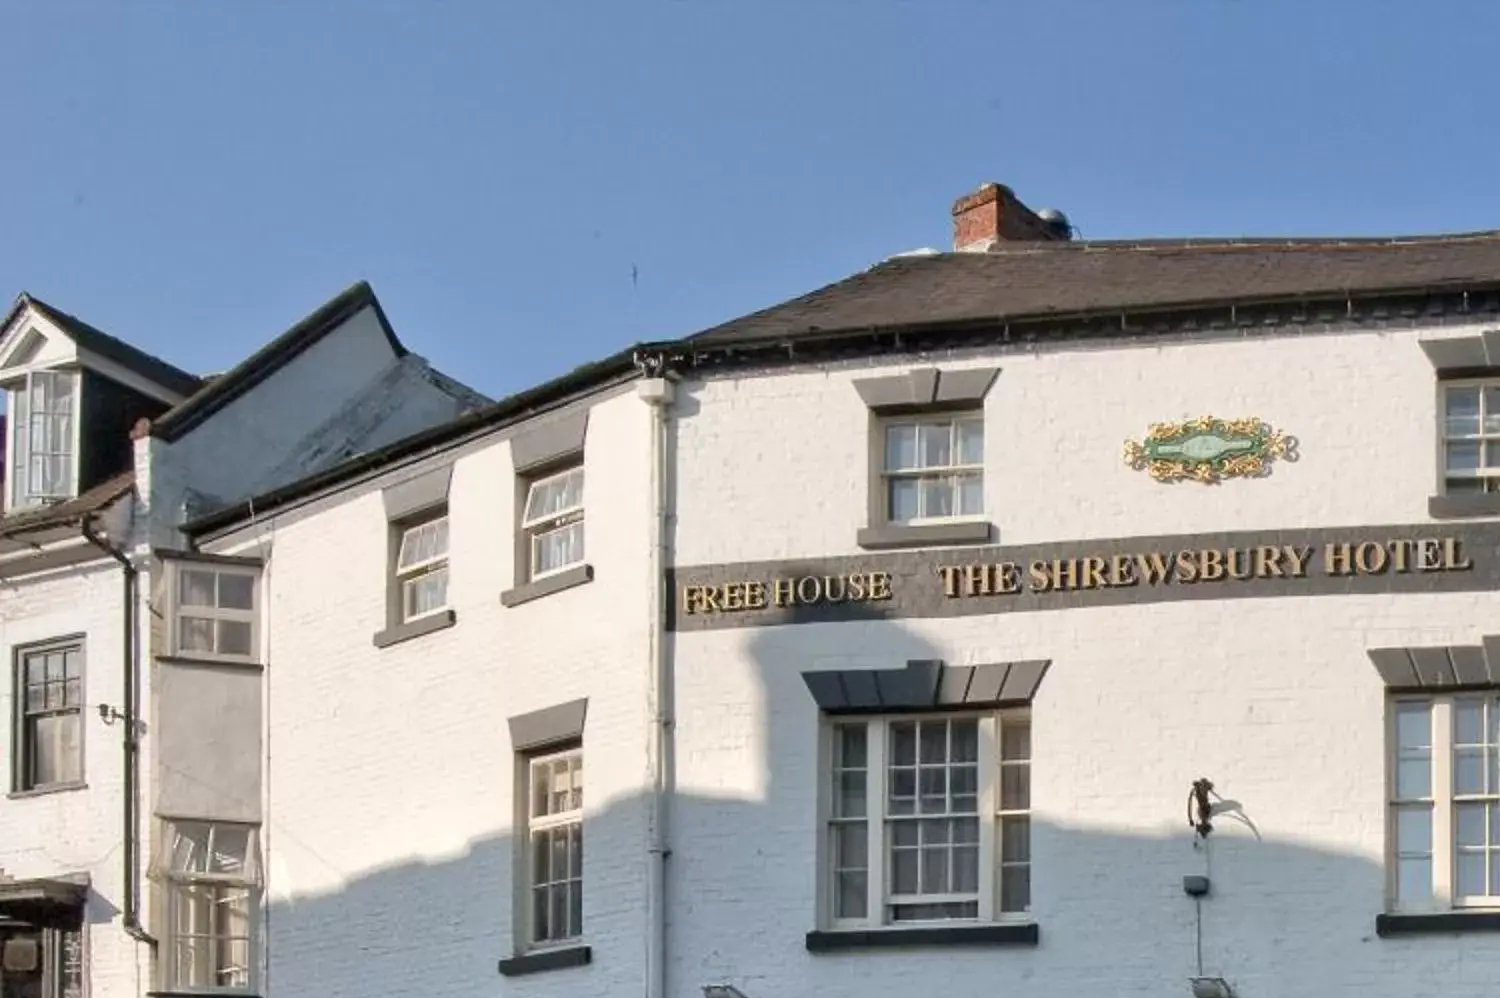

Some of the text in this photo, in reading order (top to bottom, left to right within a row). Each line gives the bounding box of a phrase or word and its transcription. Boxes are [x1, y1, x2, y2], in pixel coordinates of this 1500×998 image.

[682, 571, 892, 615] FREE HOUSE
[936, 537, 1472, 598] THE SHREWSBURY HOTEL
